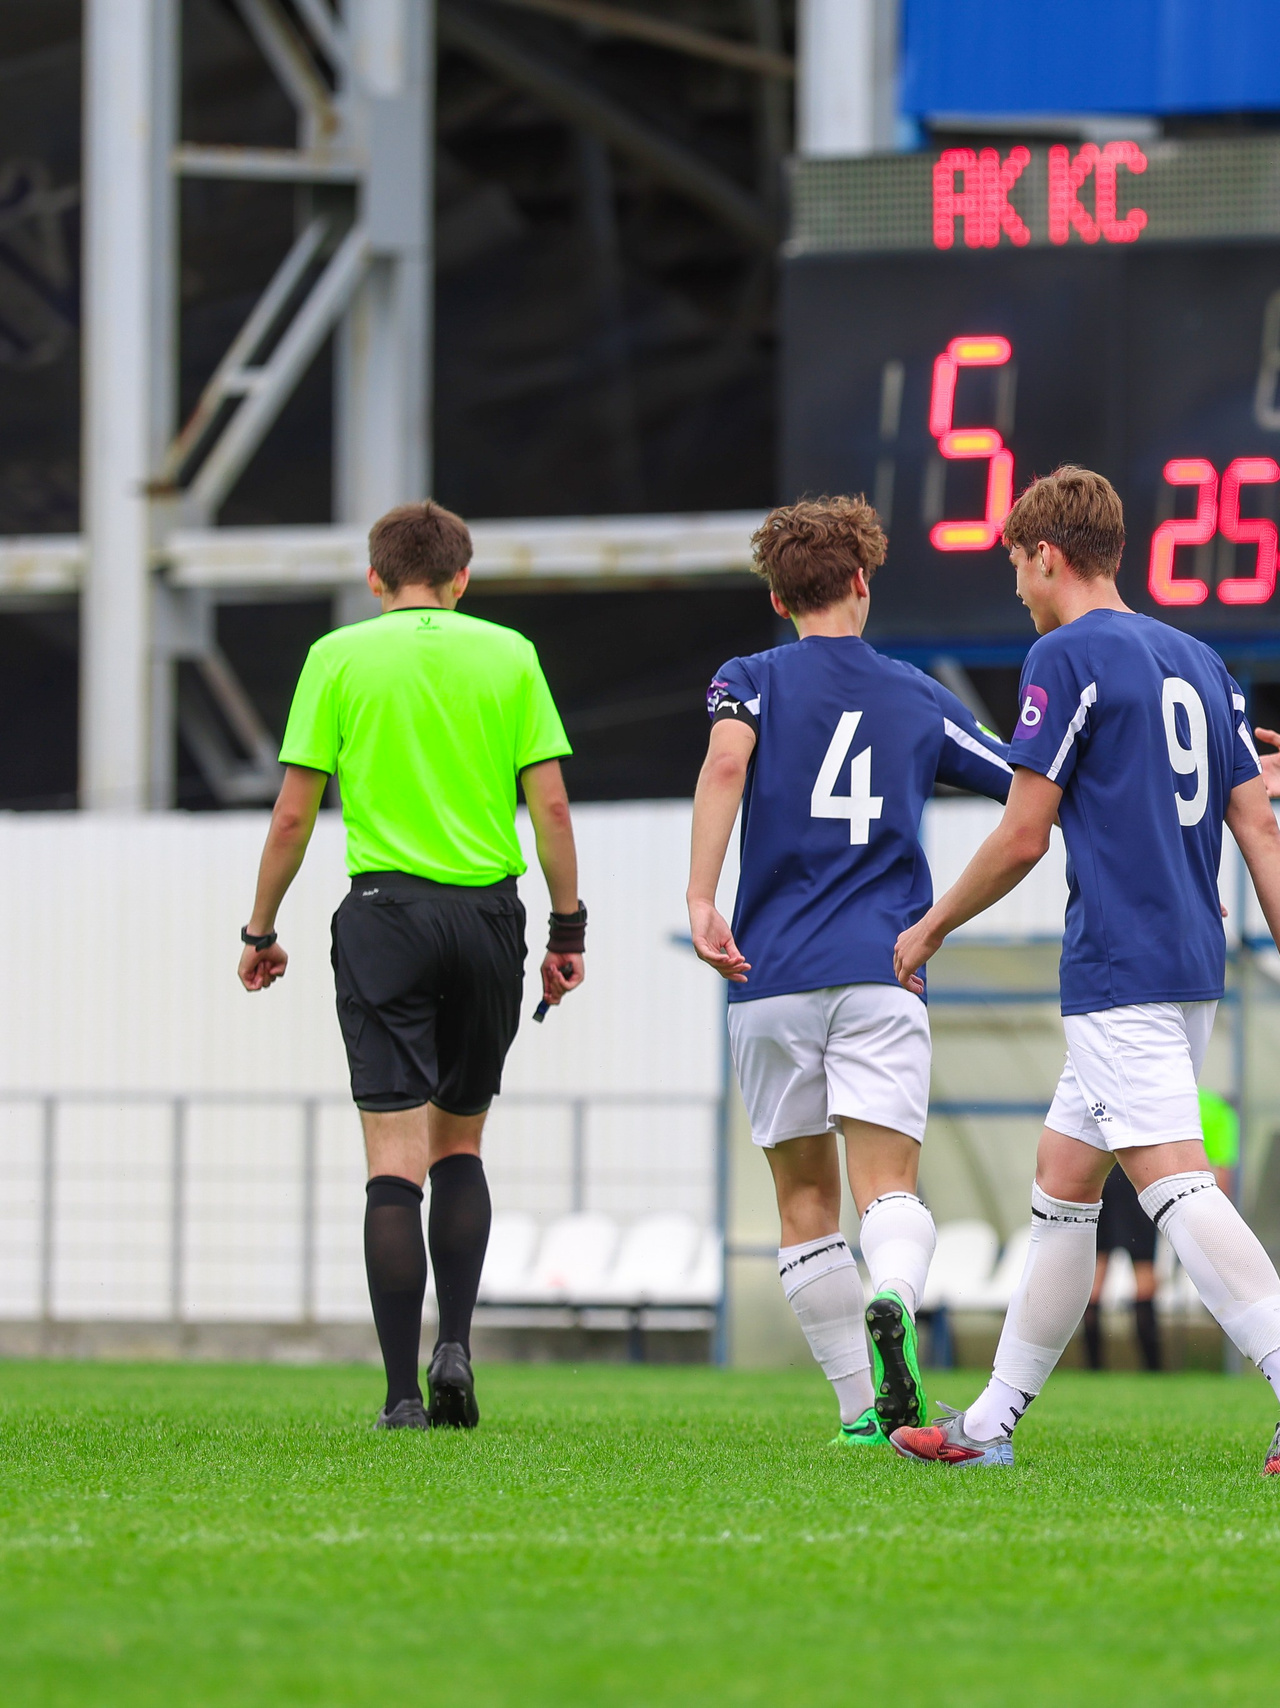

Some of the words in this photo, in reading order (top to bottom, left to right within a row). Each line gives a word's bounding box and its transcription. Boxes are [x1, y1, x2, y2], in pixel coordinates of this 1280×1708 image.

[929, 335, 1015, 552] 5
[810, 710, 884, 846] 4
[1161, 676, 1210, 827] 9
